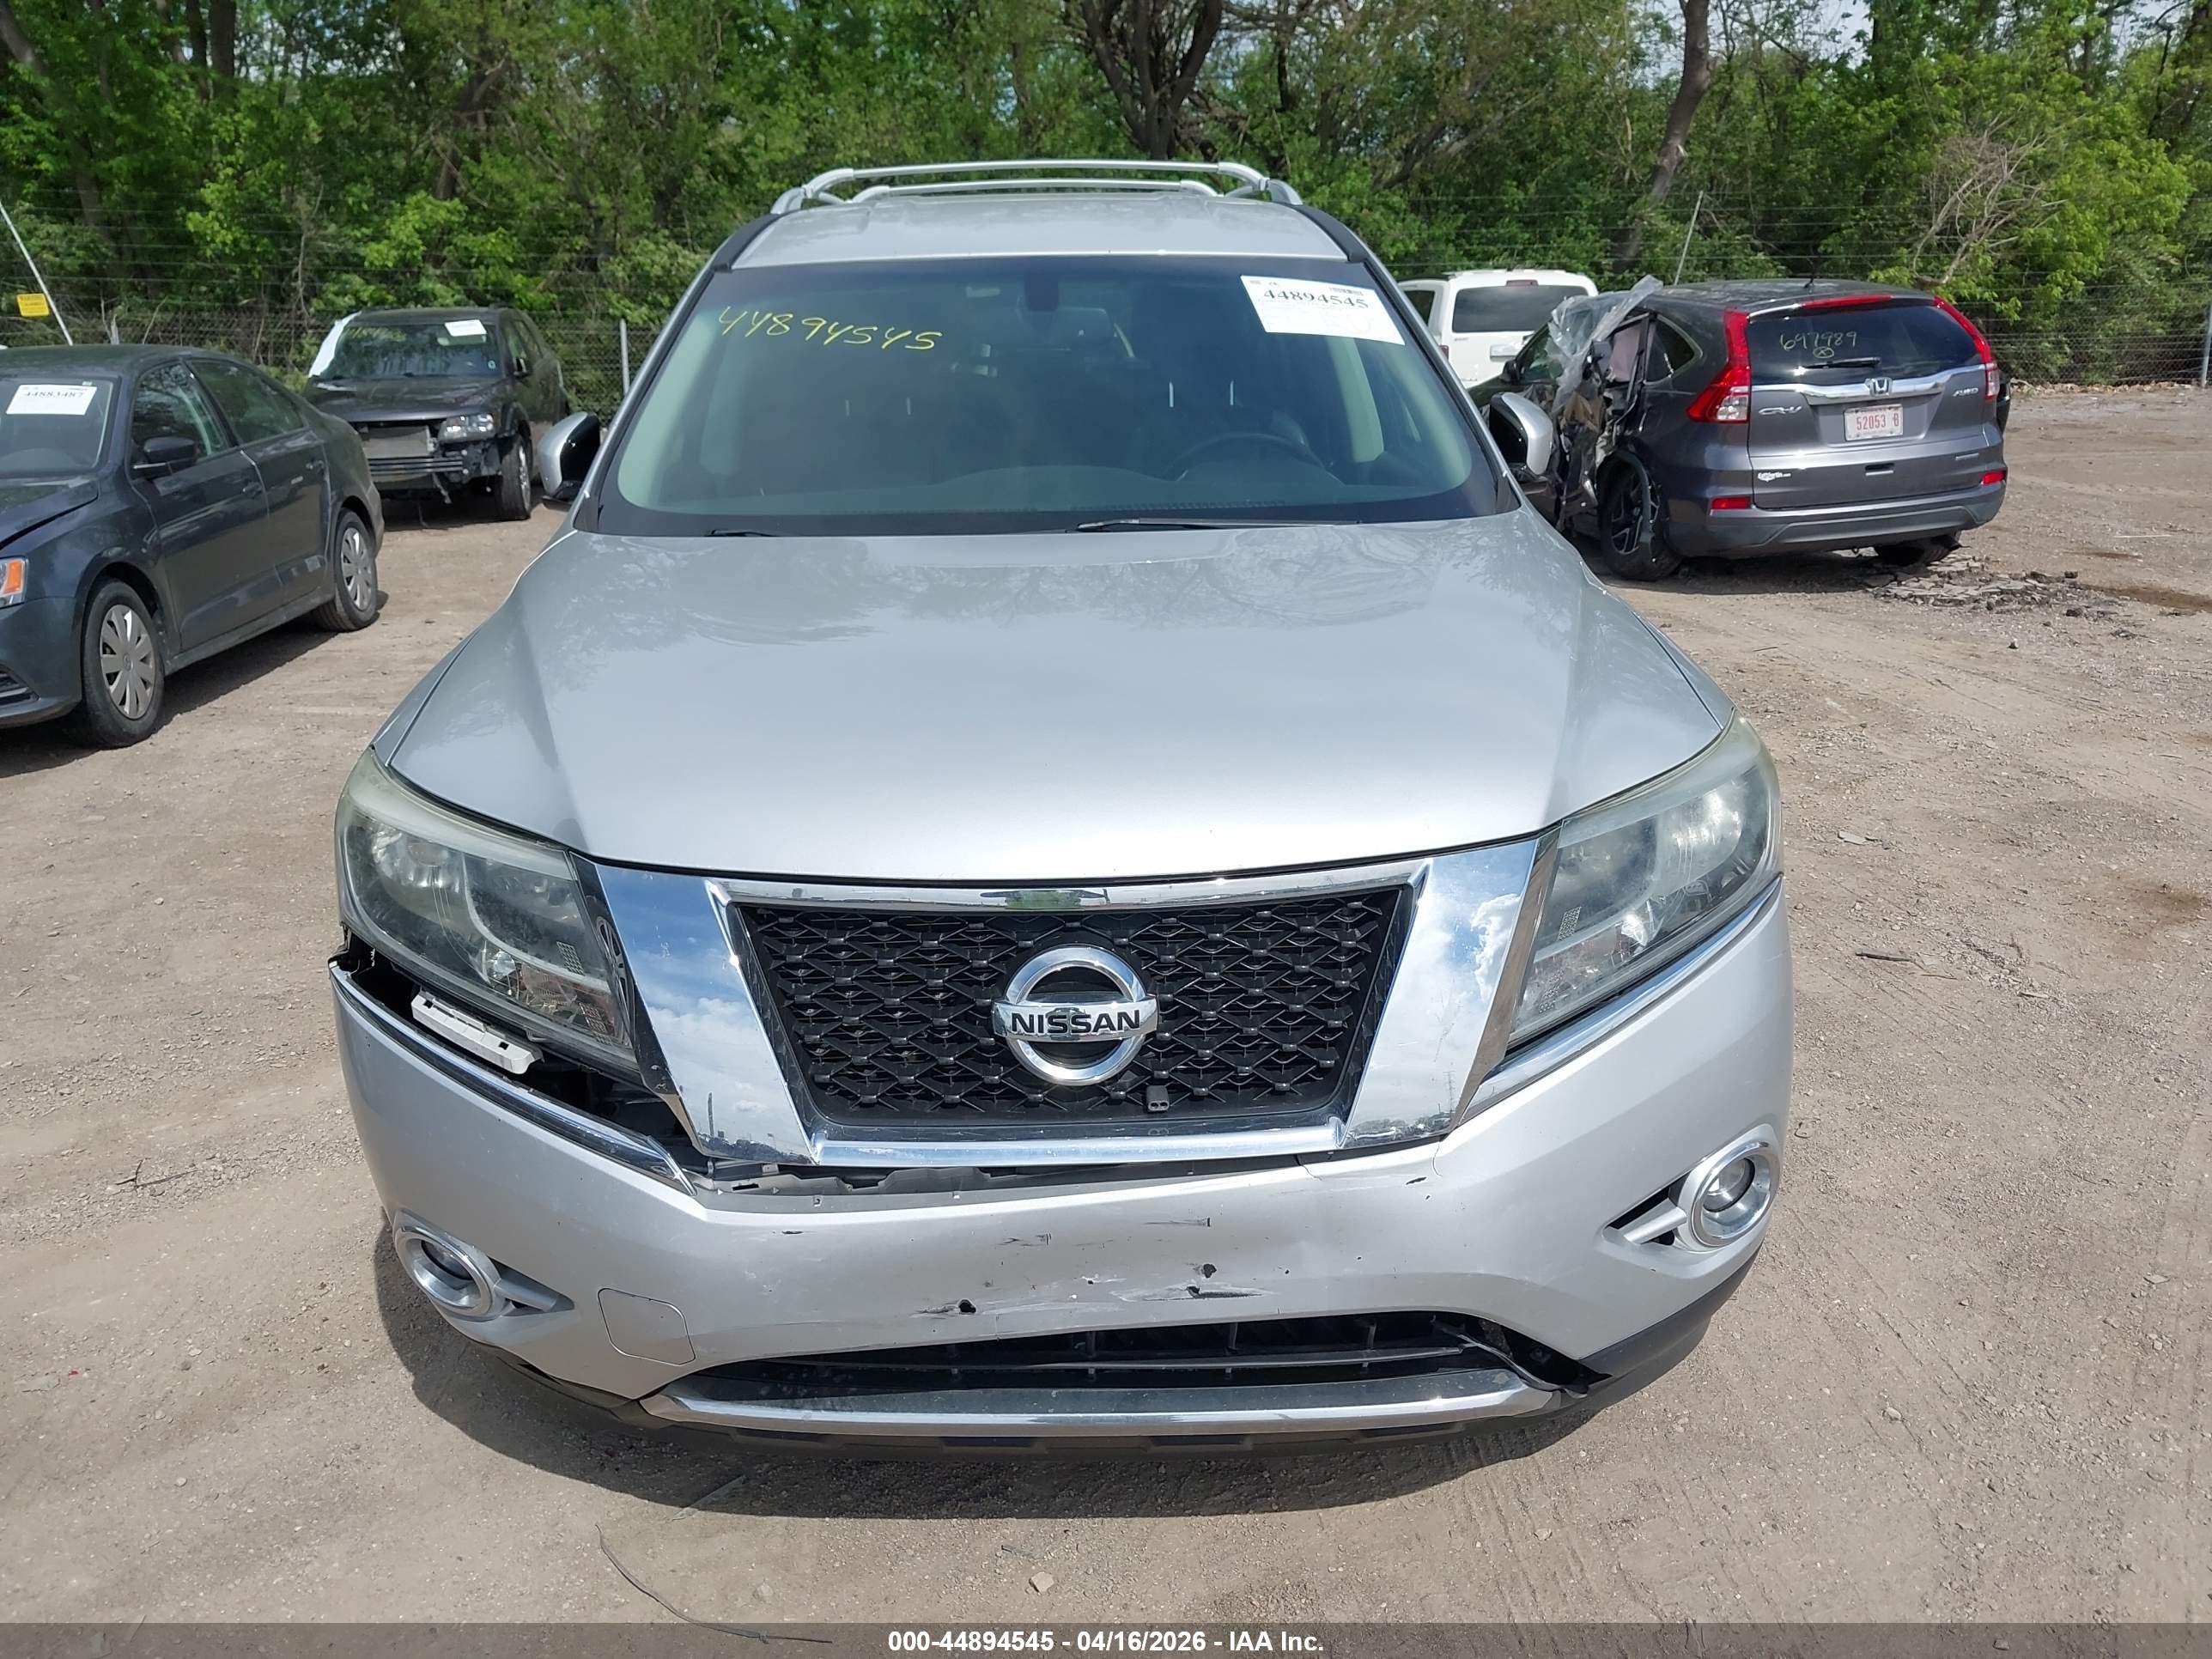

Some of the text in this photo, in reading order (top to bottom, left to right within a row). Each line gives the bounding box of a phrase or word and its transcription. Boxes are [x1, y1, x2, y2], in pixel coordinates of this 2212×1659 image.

[1263, 289, 1369, 309] 44894545
[719, 306, 943, 349] 44894545
[1856, 414, 1887, 430] 52053
[1012, 1010, 1140, 1034] NISSAN
